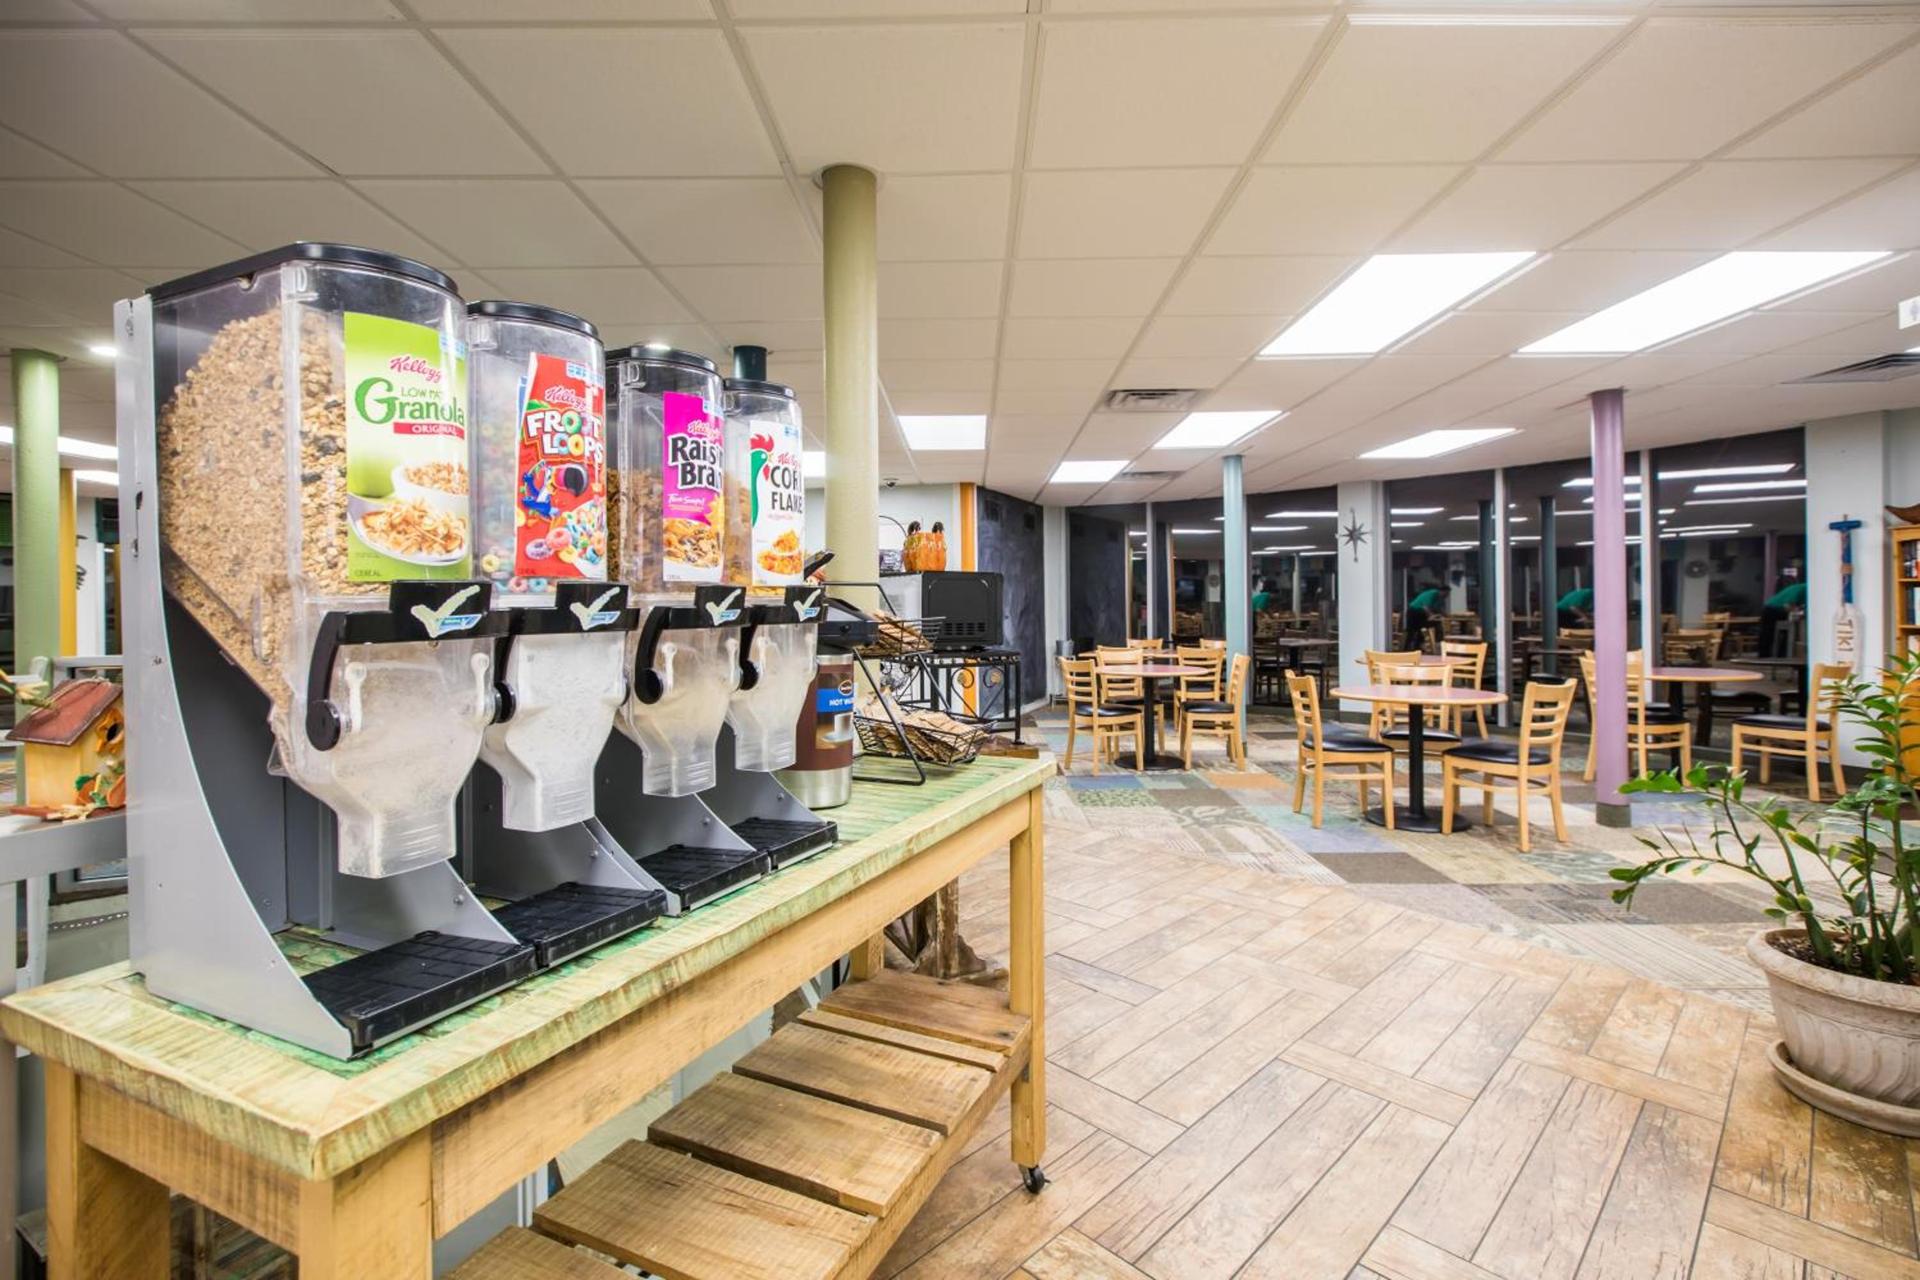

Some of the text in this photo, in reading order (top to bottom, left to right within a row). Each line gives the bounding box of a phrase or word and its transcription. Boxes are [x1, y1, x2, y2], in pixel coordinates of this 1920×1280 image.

[355, 377, 465, 425] Granola
[401, 387, 427, 397] LOW
[527, 409, 601, 438] FROOT
[542, 432, 603, 464] LOOPS
[1836, 618, 1854, 652] TIKI
